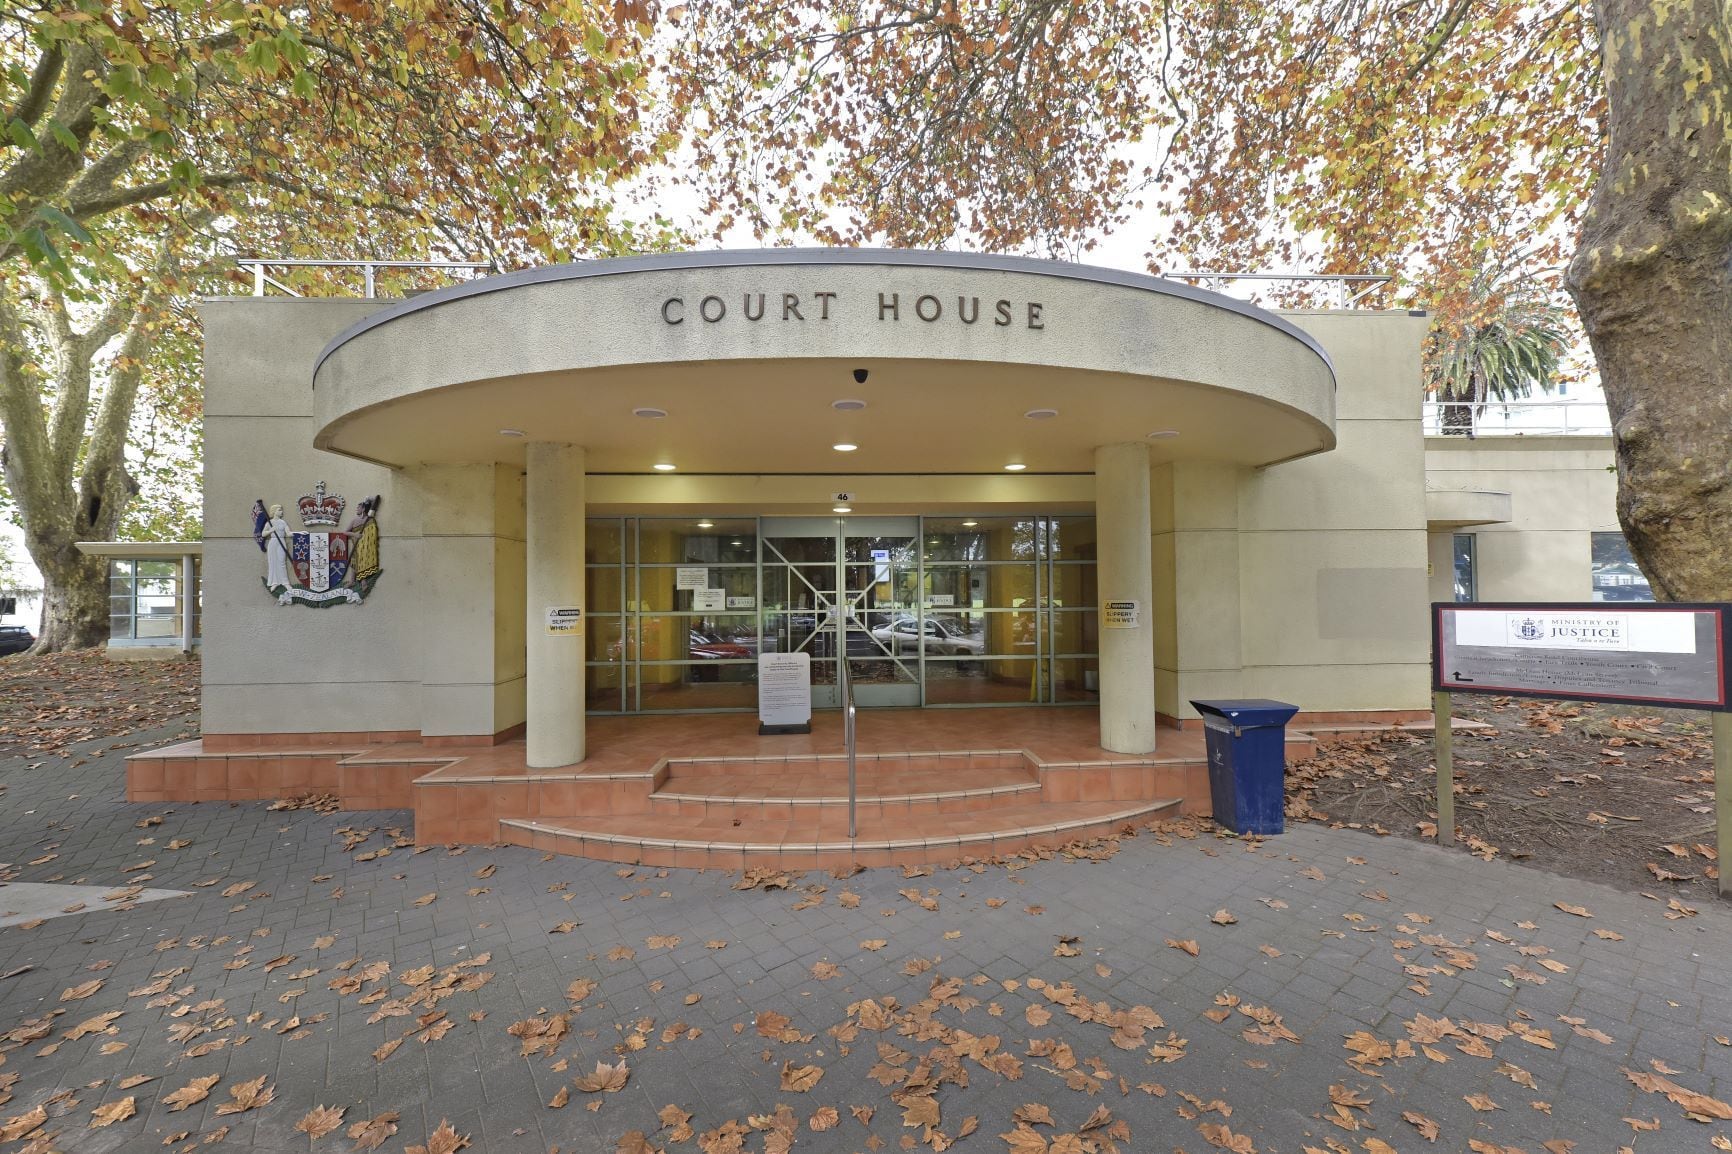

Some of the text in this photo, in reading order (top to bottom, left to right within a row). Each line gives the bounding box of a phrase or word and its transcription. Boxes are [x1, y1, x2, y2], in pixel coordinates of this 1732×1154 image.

[661, 291, 1044, 330] COURT HOUSE
[1550, 627, 1620, 638] JUSTICE
